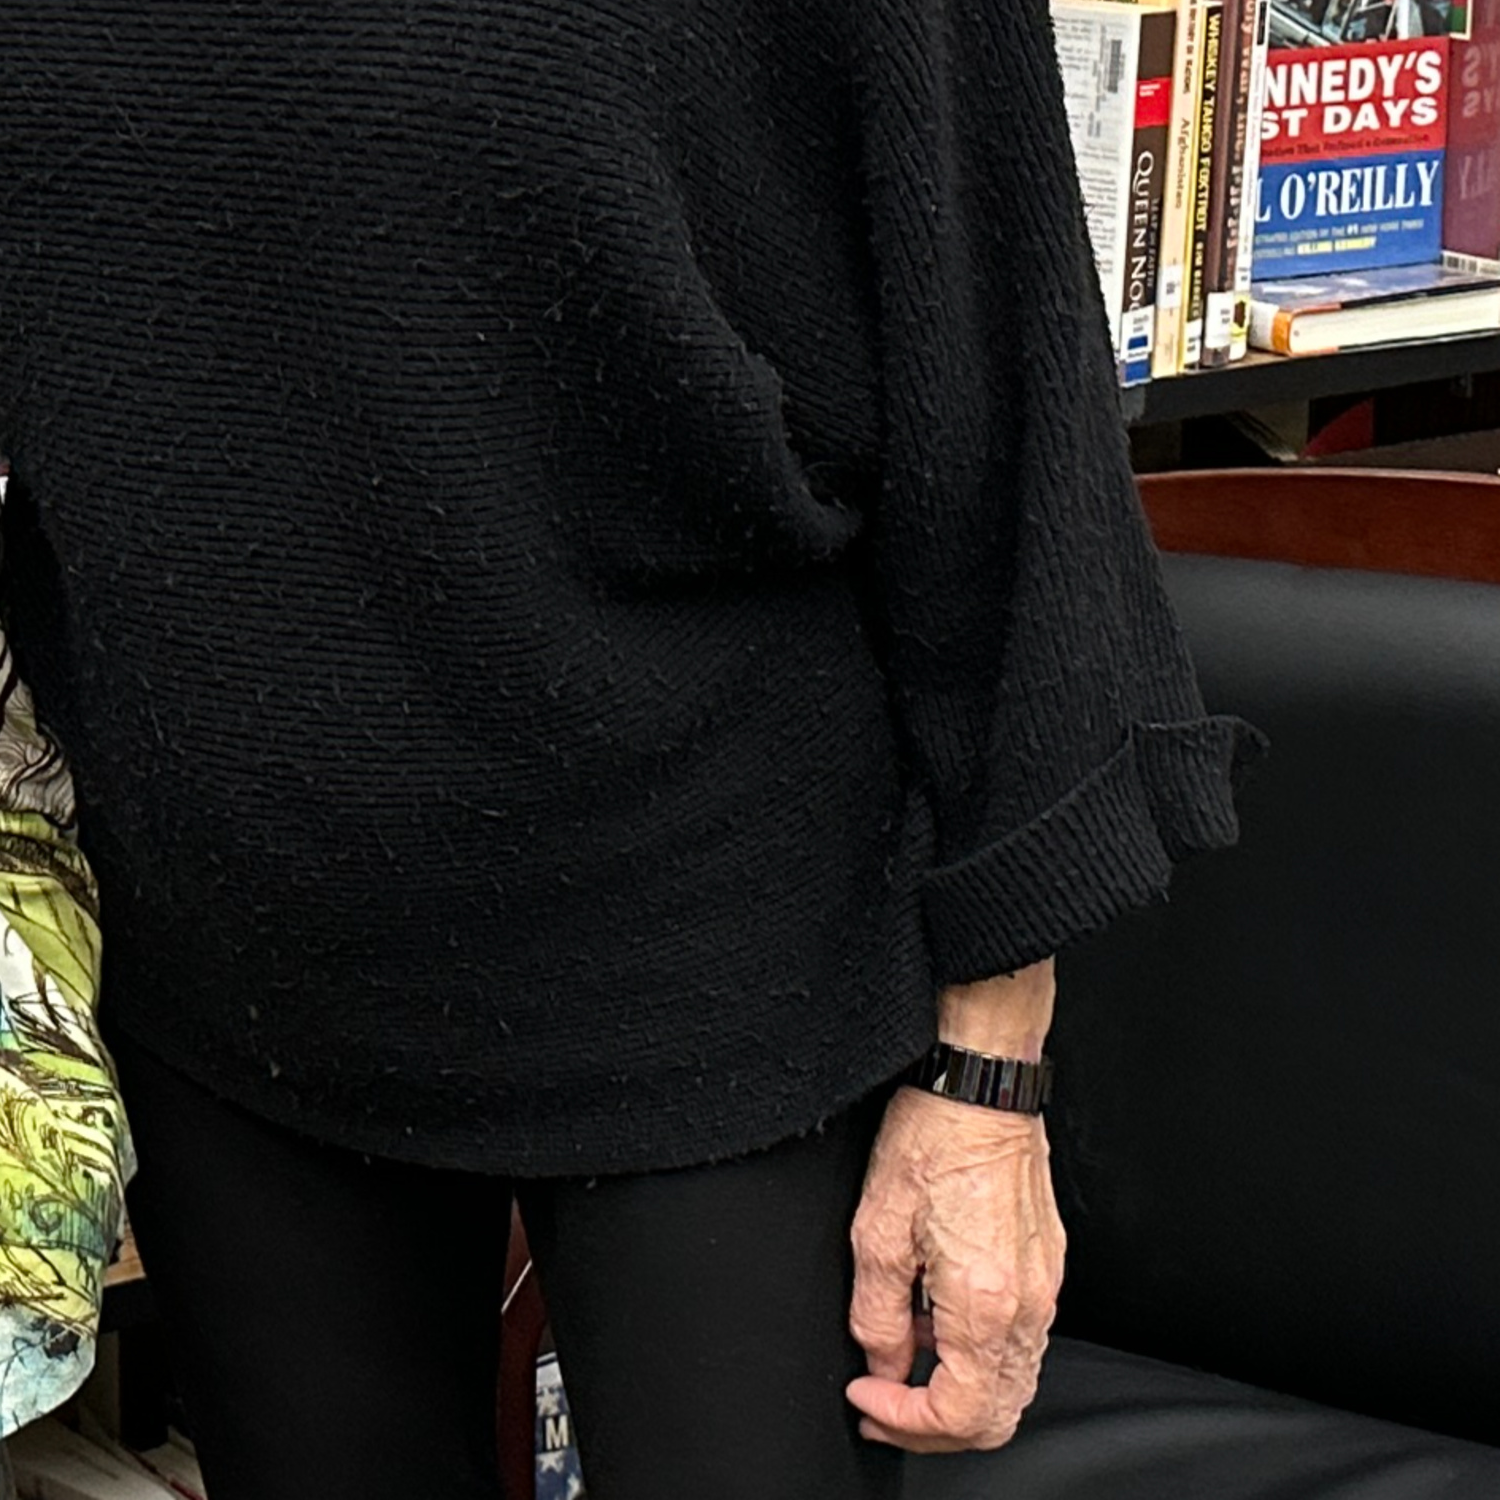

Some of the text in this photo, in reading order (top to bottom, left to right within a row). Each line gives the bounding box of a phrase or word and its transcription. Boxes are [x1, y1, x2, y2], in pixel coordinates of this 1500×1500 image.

[1195, 13, 1221, 232] WHISKEY TANGO FOXTROT
[1323, 97, 1438, 134] DAYS
[1132, 150, 1155, 248] QUEEN
[1175, 118, 1191, 209] Afghanistan
[1280, 159, 1439, 221] O'REILLY
